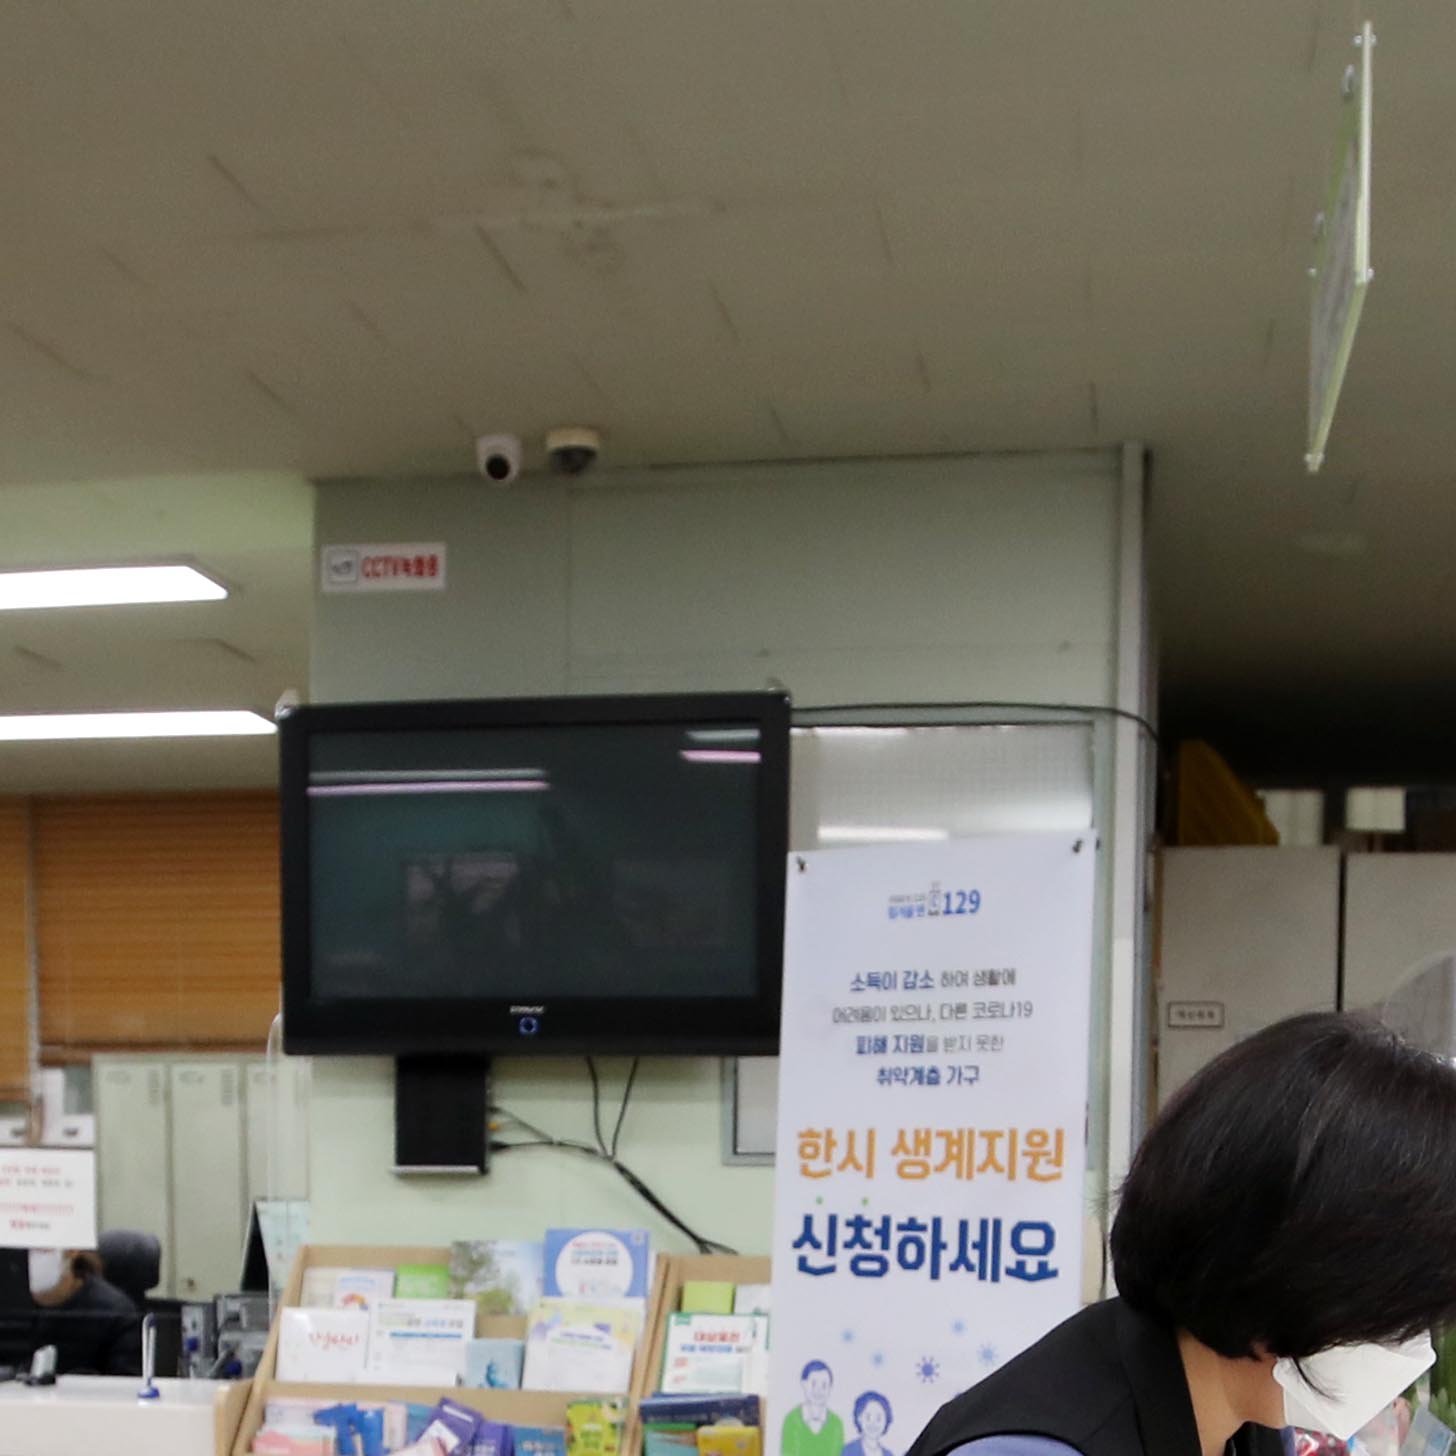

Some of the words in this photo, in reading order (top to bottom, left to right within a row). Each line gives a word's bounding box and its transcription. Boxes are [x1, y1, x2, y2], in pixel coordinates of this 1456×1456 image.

[942, 888, 982, 916] 129
[850, 970, 898, 992] 소득이
[902, 969, 935, 990] 감소
[939, 1002, 968, 1021] 다른
[972, 1000, 1034, 1019] 코로나19
[856, 1034, 888, 1055] 피해
[946, 1065, 981, 1085] 가구
[796, 1126, 877, 1180] 한시
[890, 1126, 1065, 1183] 생계지원
[792, 1213, 1060, 1284] 신청하세요
